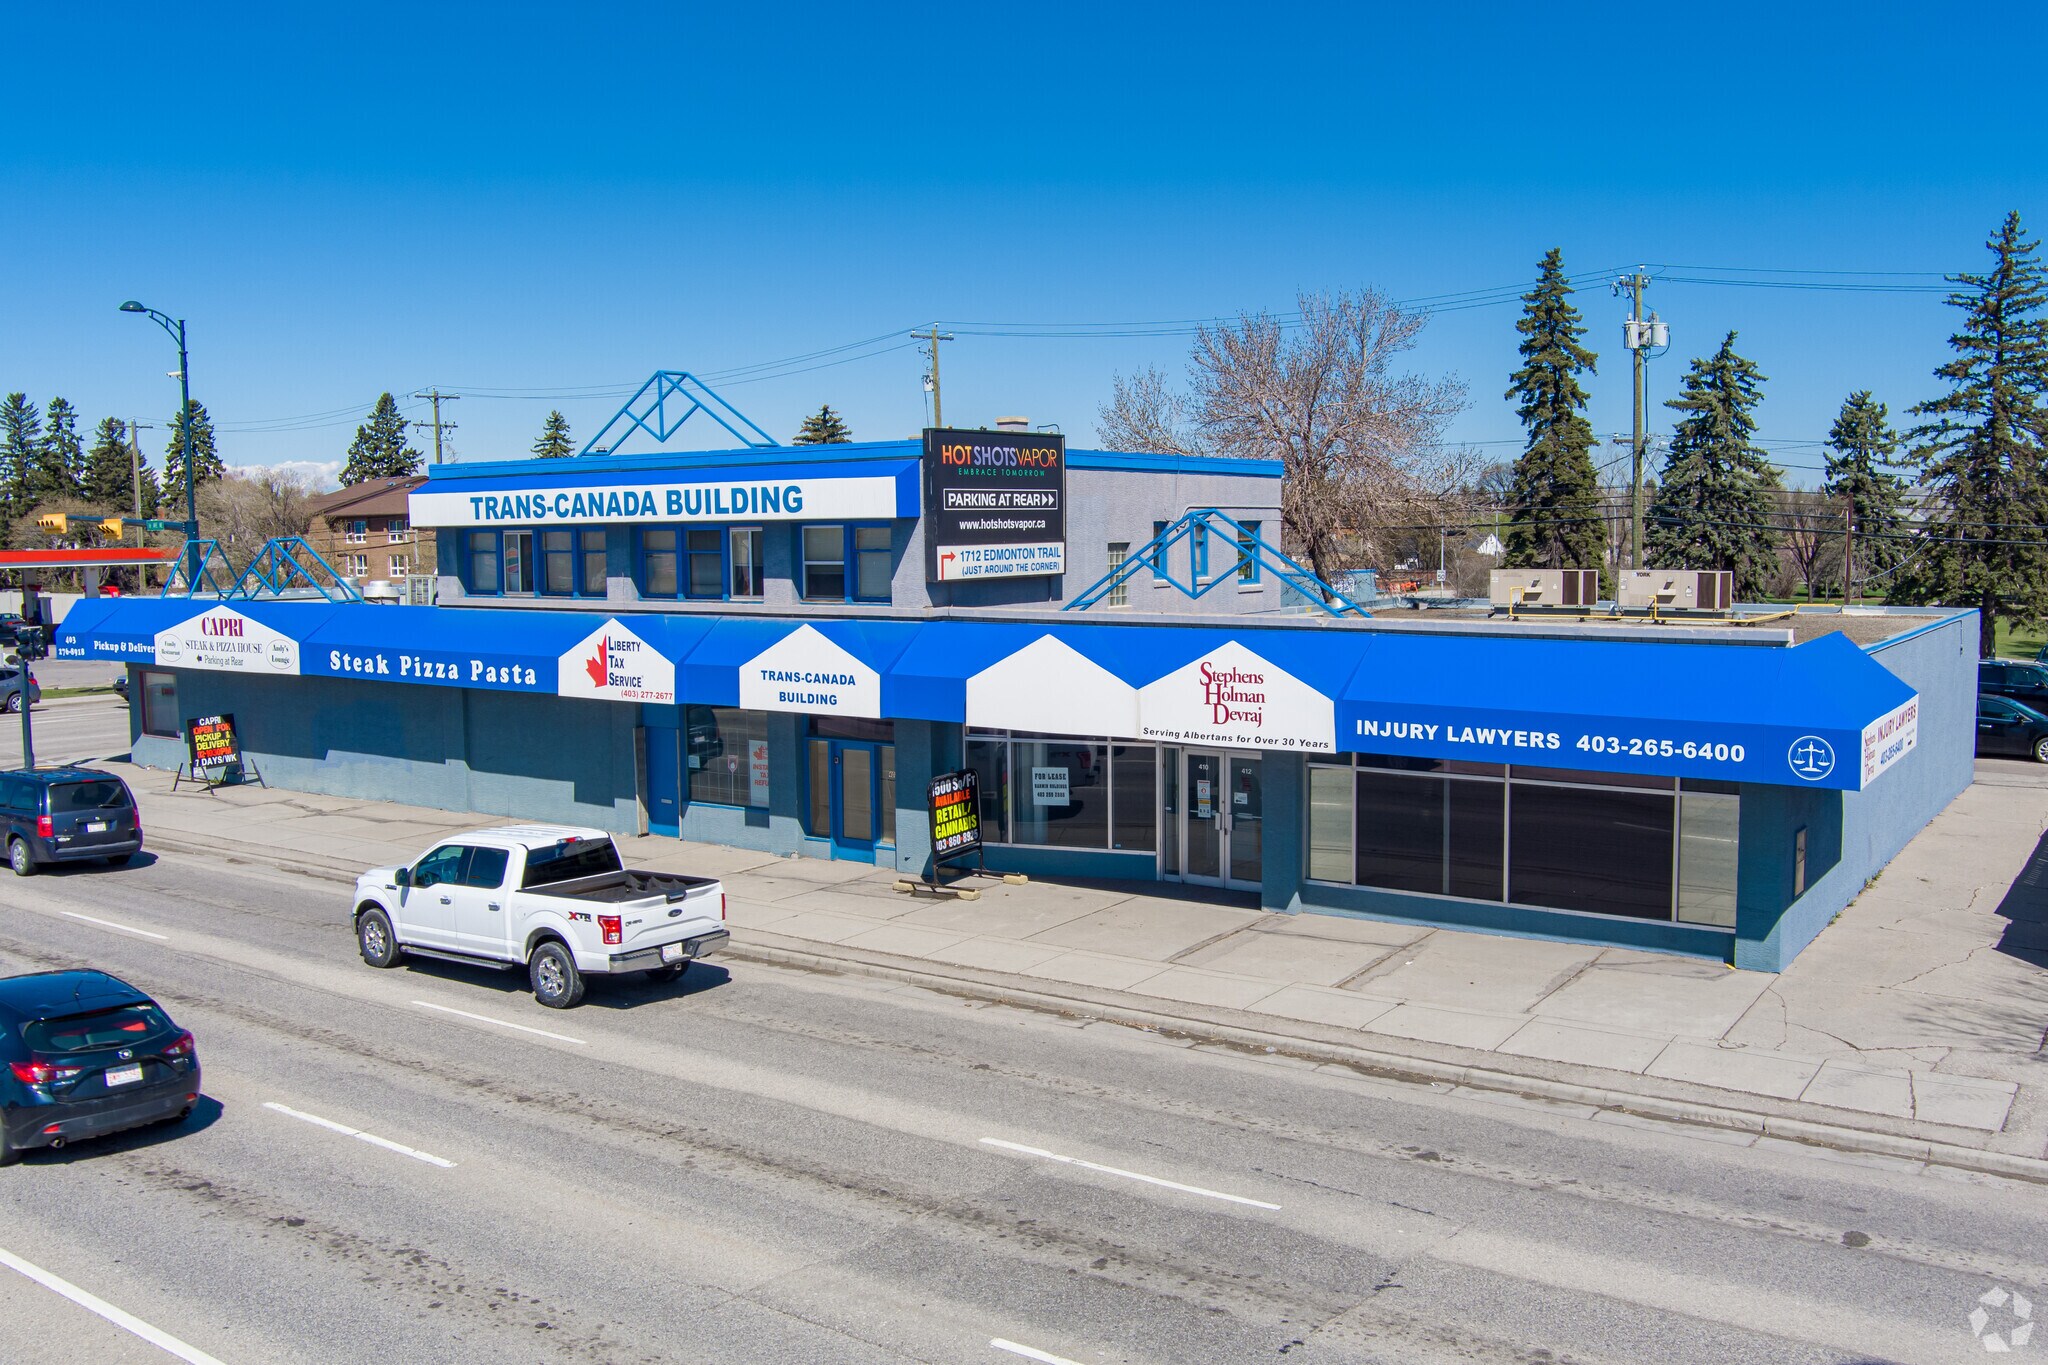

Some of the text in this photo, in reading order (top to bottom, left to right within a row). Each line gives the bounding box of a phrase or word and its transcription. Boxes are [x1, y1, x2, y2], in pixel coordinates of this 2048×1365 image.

[958, 468, 1045, 477] EMBRACE TOMORROW
[470, 485, 803, 520] TRANS-CANADA BUILDING
[948, 493, 1041, 506] PARKING AT REAR
[959, 518, 1046, 531] www.hotshotsvapor.ca
[960, 547, 1061, 562] 1712 EDMONTON TRAIL
[962, 562, 1060, 576] (JUST AROUND THE CORNER)
[201, 616, 244, 637] CAPRI
[65, 636, 76, 644] 403
[93, 640, 120, 653] Pickup
[120, 642, 127, 651] &
[185, 640, 263, 654] STEAK & PIZZA HOUSE
[608, 635, 641, 652] LIBERTY
[272, 644, 289, 654] Andy's
[204, 655, 244, 667] Parking at Rear
[271, 654, 290, 664] Lounge
[608, 655, 625, 669] TAX
[329, 650, 537, 685] Steak Pizza Pasta
[1199, 661, 1264, 688] Stephens
[608, 672, 642, 688] SERVICE
[761, 670, 856, 686] TRANS-CANADA
[620, 689, 673, 701] (403) 277-2677
[779, 691, 838, 705] BUILDING
[1204, 683, 1265, 705] Holman
[199, 716, 222, 726] CAPRI
[1212, 703, 1262, 728] Devraj
[193, 723, 231, 735] OPEN FOR
[195, 731, 222, 743] PICKUP
[1143, 727, 1329, 749] Serving Albertans for Over 30 Years
[1356, 719, 1745, 763] INJURY LAWYERS 403-265-6400
[196, 739, 230, 751] DELIVERY
[194, 754, 238, 767] 7 DAYS/WK
[935, 788, 971, 808] AVAILABLE
[935, 814, 977, 840] CANNABIS
[568, 911, 592, 922] XTR
